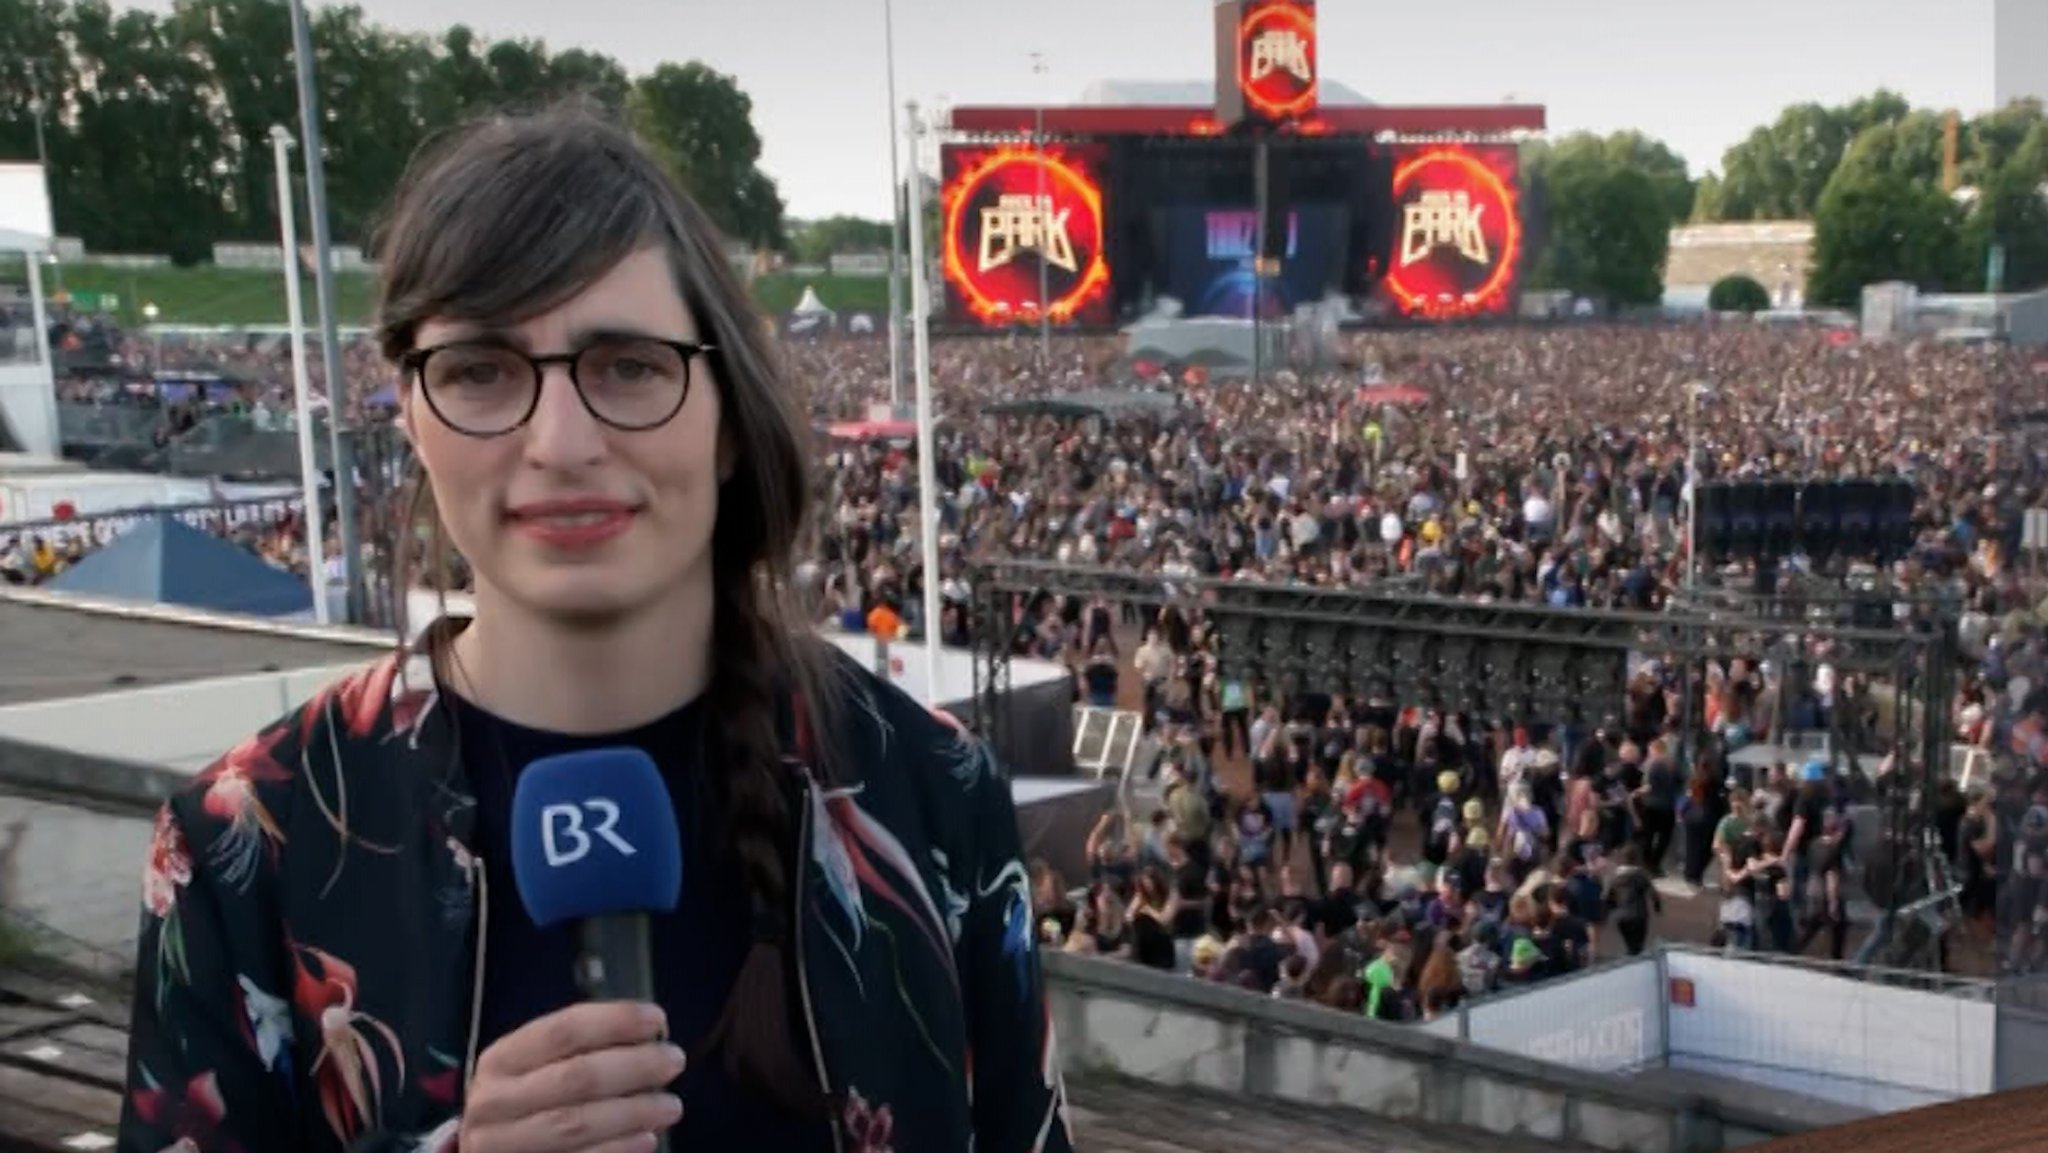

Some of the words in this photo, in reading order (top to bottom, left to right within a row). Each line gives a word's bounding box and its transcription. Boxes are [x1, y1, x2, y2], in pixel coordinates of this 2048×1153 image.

[978, 207, 1078, 272] PARK
[1400, 203, 1489, 267] PARK
[541, 797, 637, 867] BR
